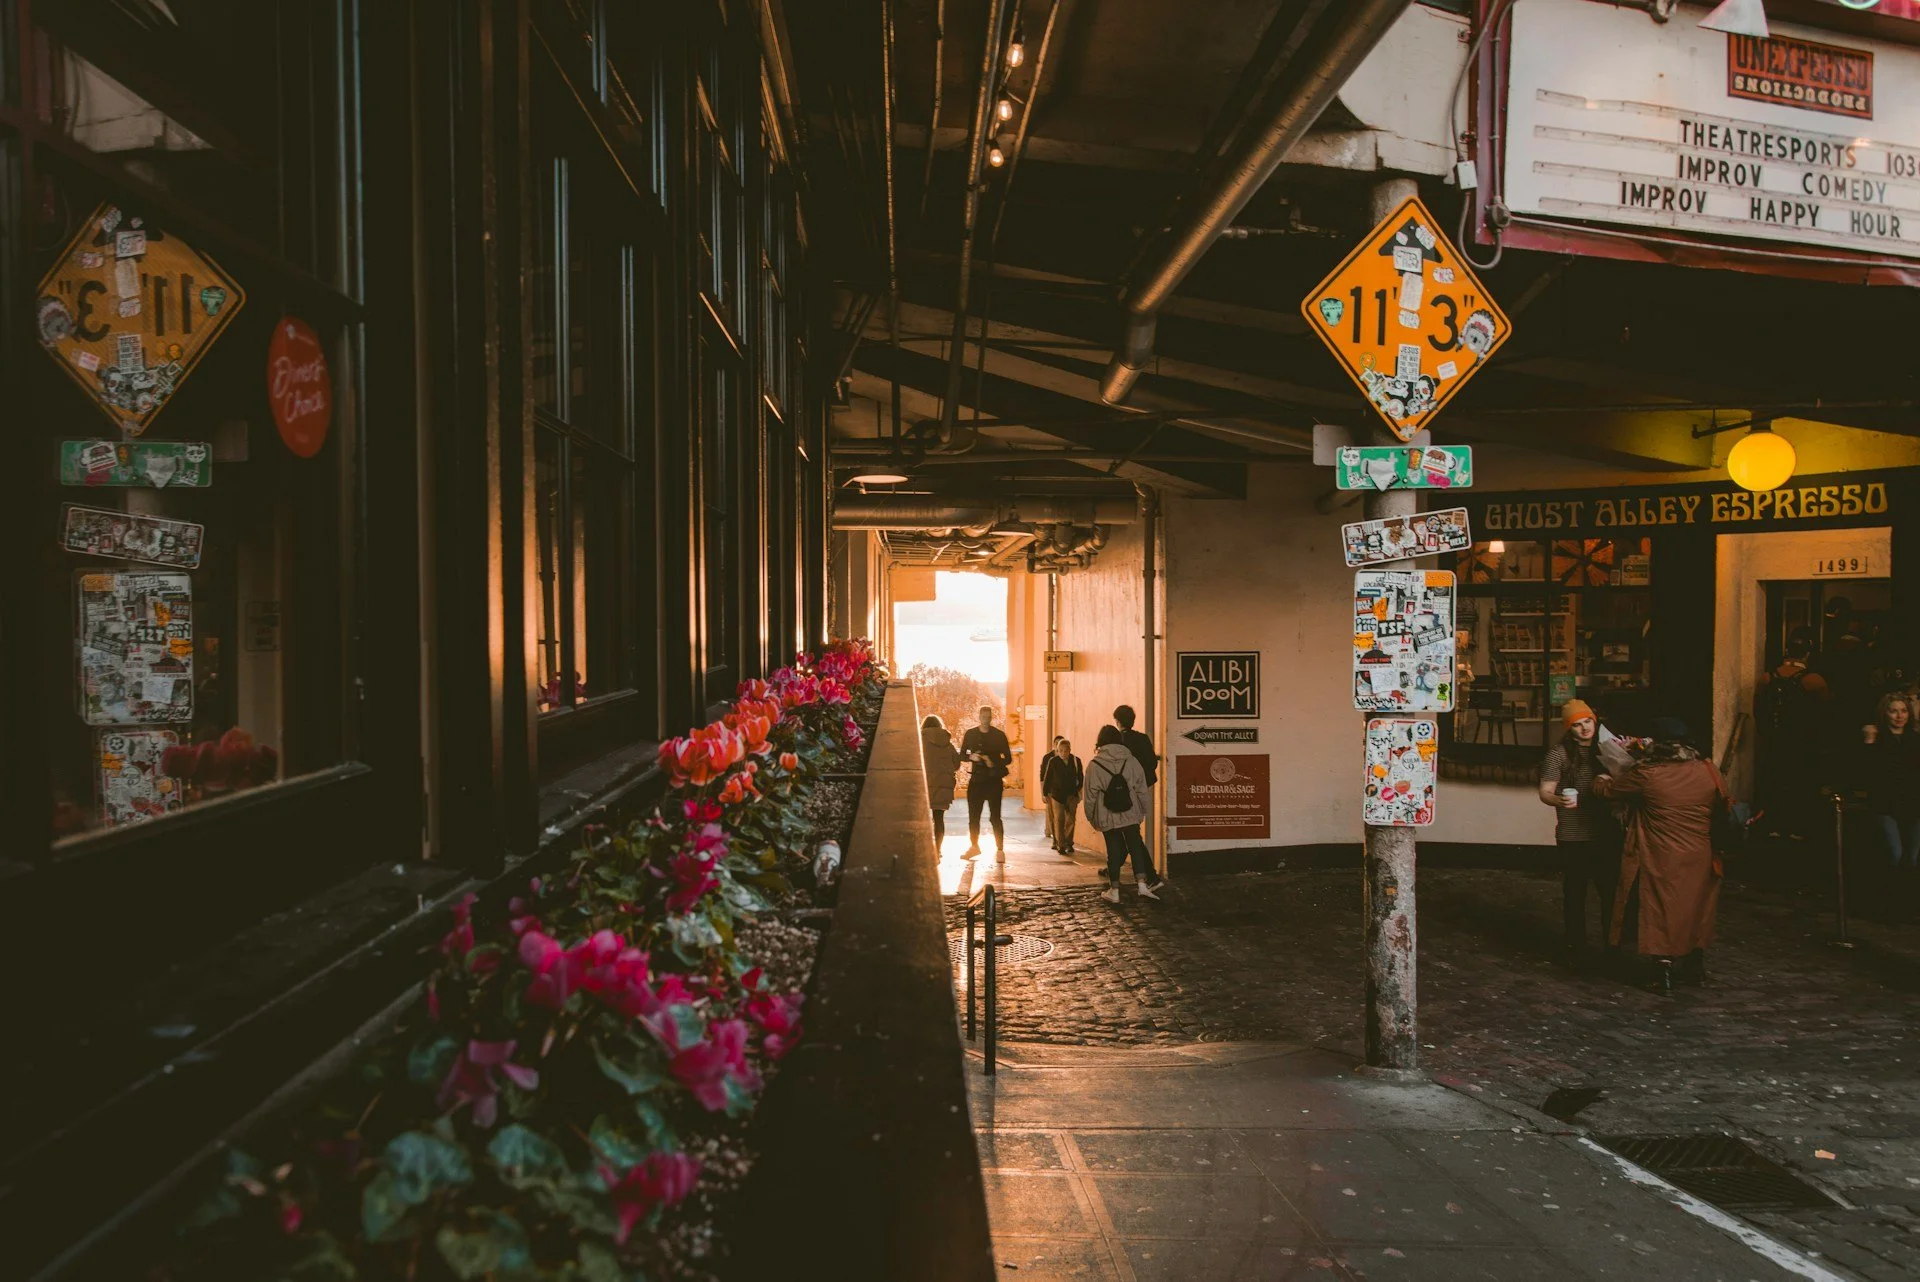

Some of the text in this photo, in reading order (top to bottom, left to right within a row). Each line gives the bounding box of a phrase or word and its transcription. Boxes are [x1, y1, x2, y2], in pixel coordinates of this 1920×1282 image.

[1736, 34, 1868, 90] UNEXPECTED
[1734, 75, 1866, 111] PRODUCTIONS
[1680, 119, 1920, 178] THEATRESPORTS 103
[1679, 155, 1887, 203] IMPROV COMEDY
[1621, 180, 1901, 238] IMPROV HAPPY HOUR
[1485, 483, 1889, 531] GHOST ALLEY ESPRESSO
[1818, 558, 1860, 574] 1499
[1189, 659, 1250, 684] ALIBI
[1186, 686, 1251, 711] ROOM
[1194, 731, 1255, 740] DOWN THE ALLEY
